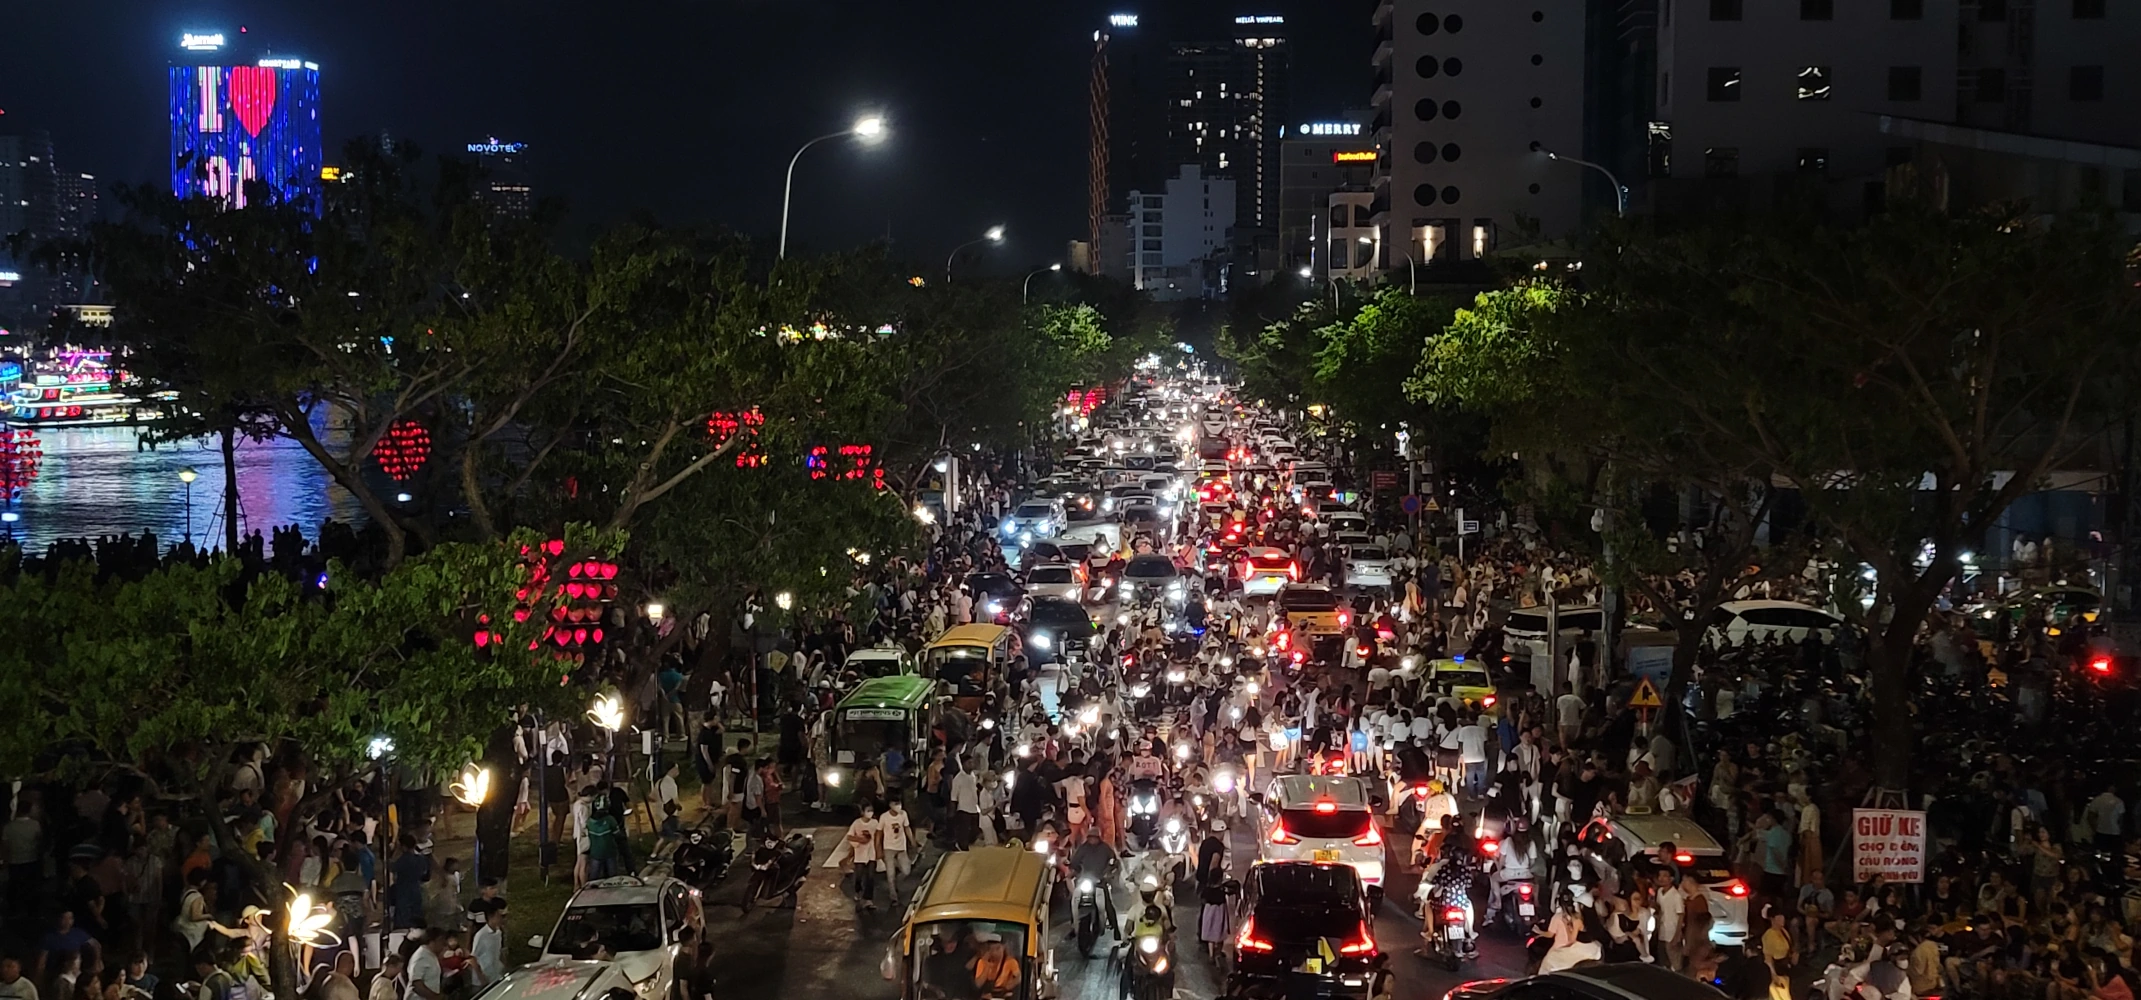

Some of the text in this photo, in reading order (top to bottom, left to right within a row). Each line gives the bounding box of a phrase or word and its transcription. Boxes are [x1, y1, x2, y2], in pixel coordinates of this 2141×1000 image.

[1256, 16, 1284, 24] VINPEARL
[259, 59, 301, 68] COURTYARD
[1312, 123, 1361, 135] MERRY
[467, 143, 517, 153] NOVOTEL
